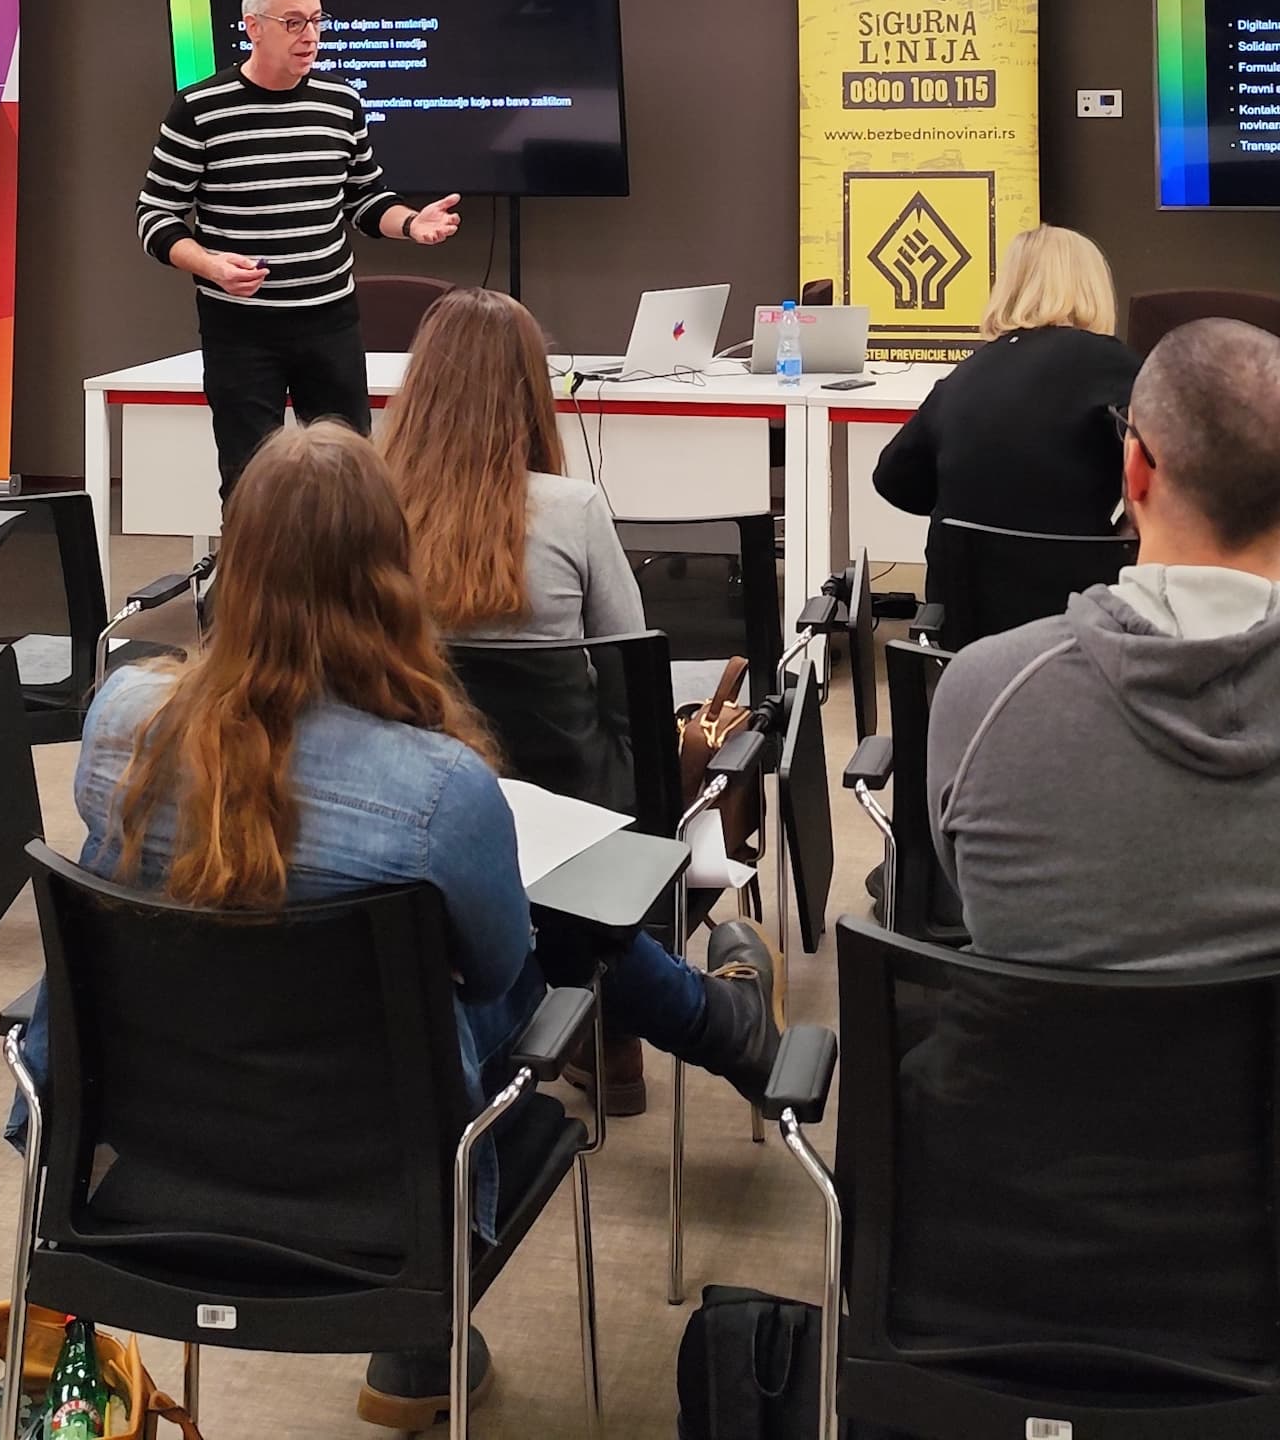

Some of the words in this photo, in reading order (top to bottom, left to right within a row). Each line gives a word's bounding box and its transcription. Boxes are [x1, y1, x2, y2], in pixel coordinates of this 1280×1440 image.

[333, 20, 350, 31] (ne
[351, 20, 380, 31] dajmo
[381, 19, 394, 29] im
[859, 10, 977, 36] SIGURNA
[349, 40, 389, 50] novinara
[343, 58, 386, 71] odgovora
[388, 58, 427, 70] unapred
[850, 78, 905, 104] 0800
[910, 76, 948, 102] 100
[954, 76, 989, 102] 115
[1238, 83, 1274, 94] Pravni
[361, 98, 412, 108] unarodnim
[413, 96, 469, 109] organizacije
[470, 96, 491, 109] koje
[492, 98, 505, 107] se
[824, 126, 1016, 140] www.bezbedninovinari.rs
